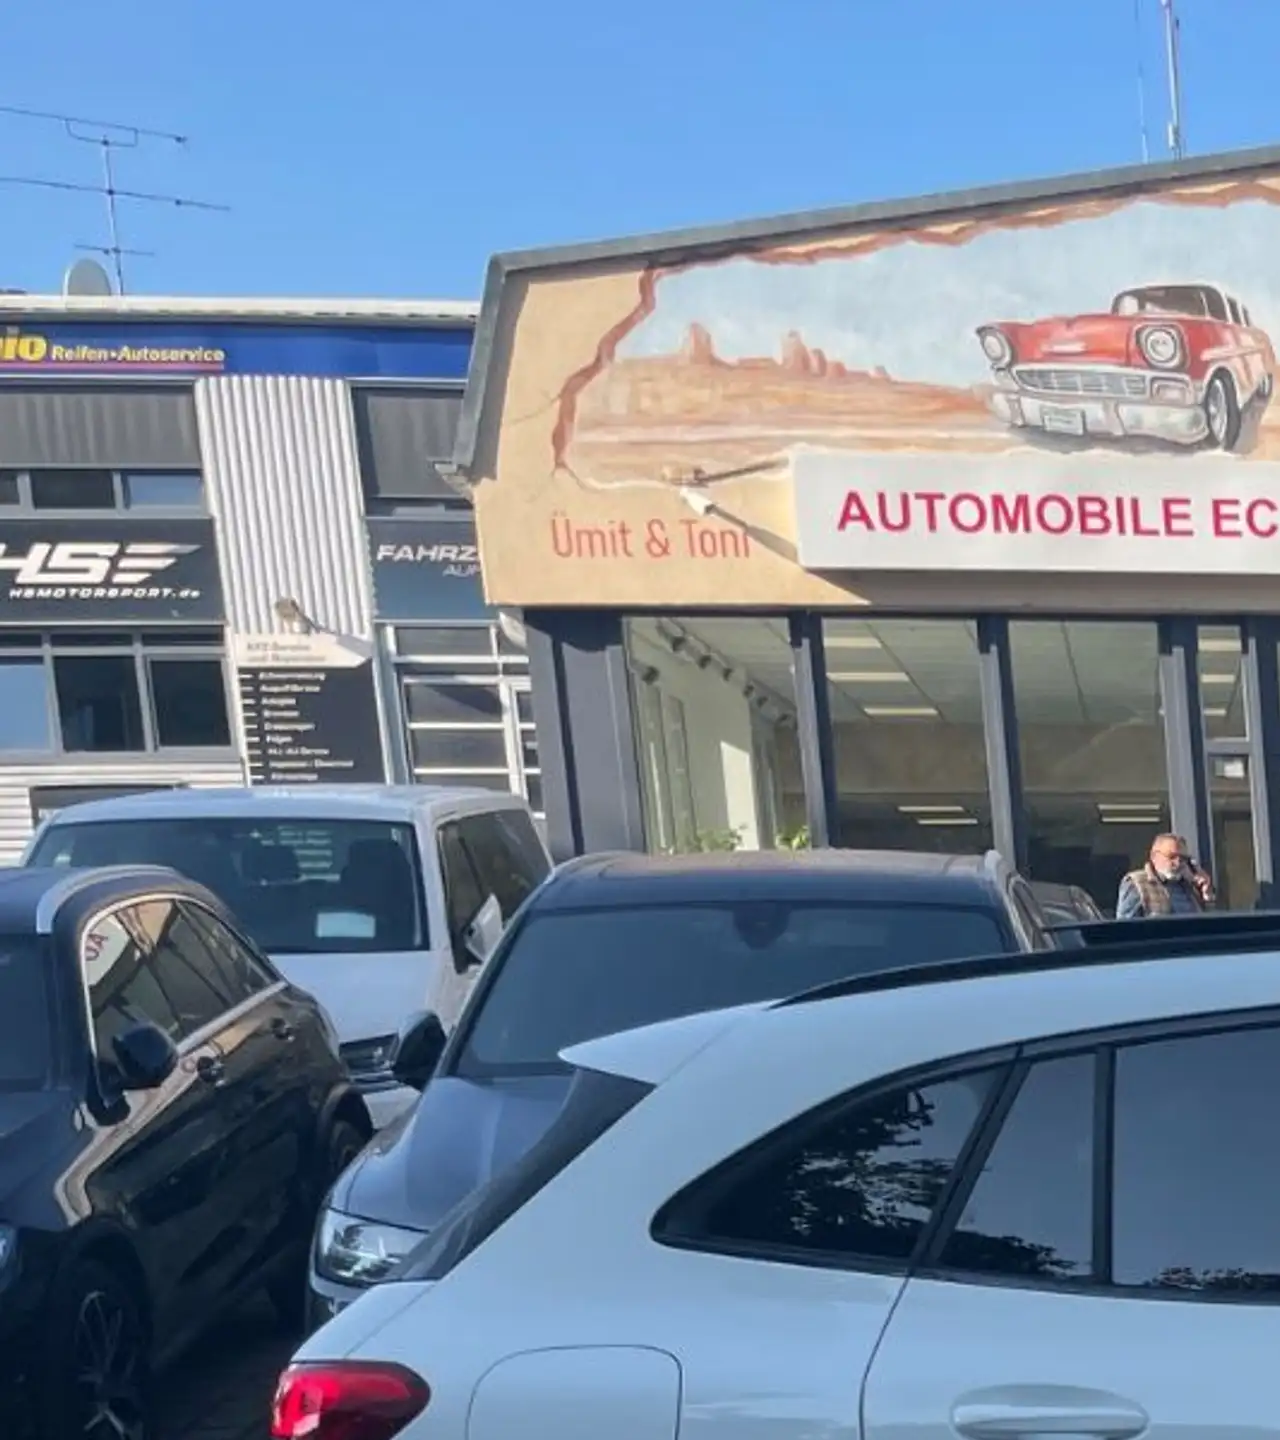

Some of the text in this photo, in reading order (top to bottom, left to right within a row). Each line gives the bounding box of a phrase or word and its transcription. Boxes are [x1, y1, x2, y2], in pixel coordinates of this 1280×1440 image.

[551, 510, 634, 558] Ümit
[645, 519, 671, 558] &
[837, 491, 1195, 537] AUTOMOBILE
